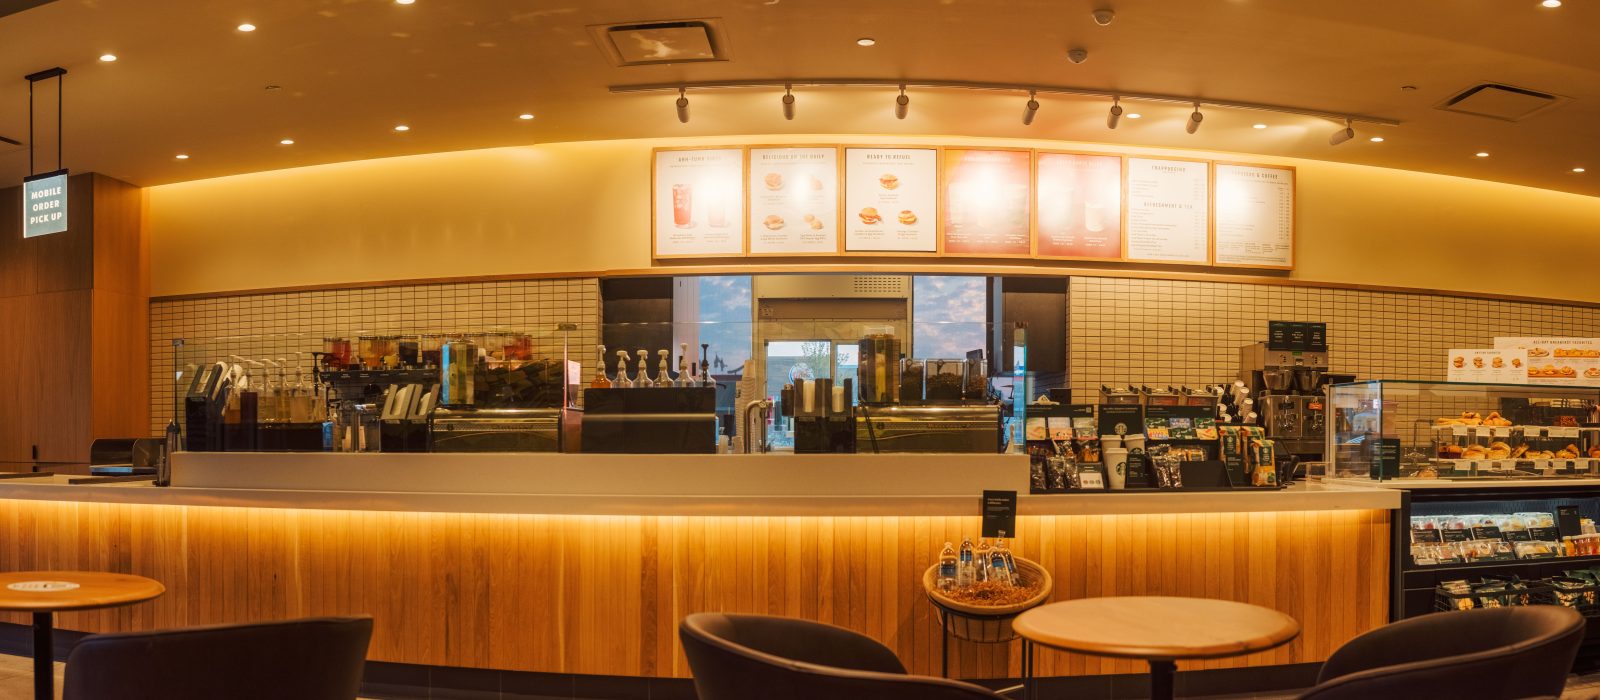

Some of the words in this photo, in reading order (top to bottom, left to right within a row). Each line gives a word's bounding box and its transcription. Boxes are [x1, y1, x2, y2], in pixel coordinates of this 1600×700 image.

[31, 187, 62, 200] MOBILE
[32, 199, 60, 212] ORDER
[30, 214, 49, 225] PICK
[51, 212, 62, 221] UP
